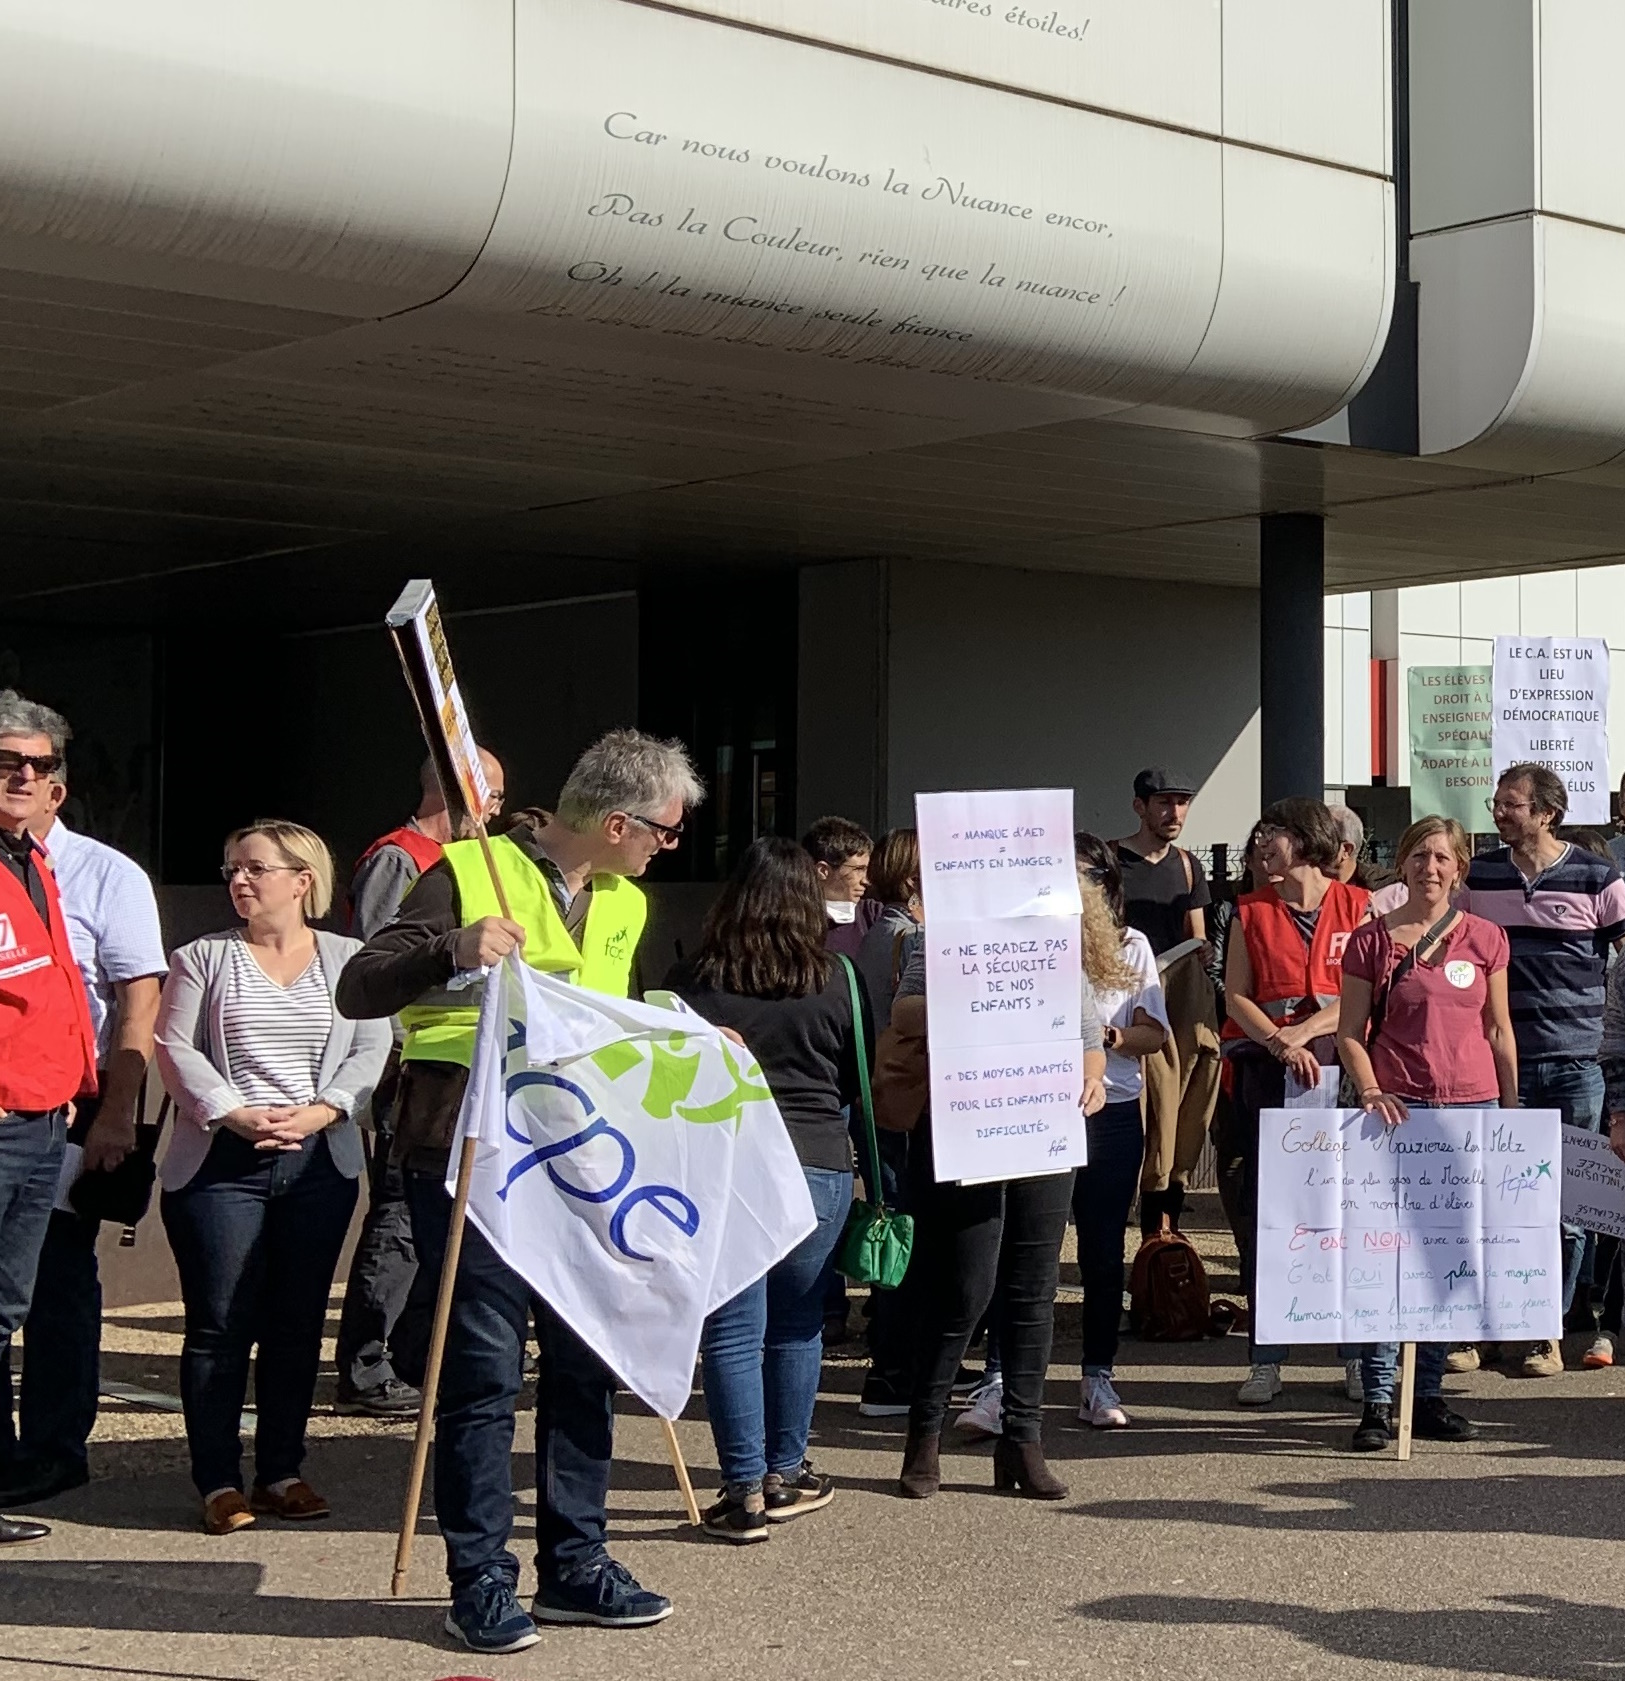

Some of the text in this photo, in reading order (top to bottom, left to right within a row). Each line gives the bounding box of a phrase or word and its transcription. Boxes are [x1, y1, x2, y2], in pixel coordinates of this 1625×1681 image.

[1005, 6, 1090, 41] étoiles!
[602, 111, 1114, 239] Car nous voulons la Nuance encor,
[588, 192, 664, 229] Pas
[676, 205, 707, 238] la
[722, 215, 844, 263] Couleur,
[859, 247, 910, 273] rien
[921, 262, 969, 290] que
[979, 262, 1005, 289] la
[1015, 278, 1102, 306] nuance
[567, 260, 622, 287] Oh
[660, 276, 691, 298] la
[702, 289, 803, 317] nuance
[814, 307, 883, 329] seule
[889, 313, 974, 345] fiance
[1509, 647, 1593, 660] LE C.A. EST UN
[1422, 676, 1441, 687] LES
[1444, 673, 1485, 686] ÉLÈVES
[1539, 669, 1565, 680] LIEU
[1434, 693, 1470, 705] DROIT
[1474, 691, 1482, 703] À
[1510, 688, 1594, 701] D'EXPRESSION
[1422, 712, 1492, 724] ENSEIGNEM
[1503, 707, 1600, 723] DÉMOCRATIQUE
[1438, 729, 1492, 742] SPÉCIALIS
[1530, 737, 1575, 751] LIBERTÉ
[1421, 755, 1467, 769] ADAPTÉ
[1567, 779, 1595, 792] ÉLUS
[964, 827, 1008, 841] MANQUE
[934, 856, 1053, 872] ENFANTS EN DANGER
[959, 939, 1068, 957] NE BRADEZ PAS
[962, 955, 1057, 975] LA SÉCURITÉ
[986, 979, 1034, 993] DE NOS
[970, 997, 1032, 1012] ENFANTS
[958, 1060, 1073, 1082] DES MOYENS ADAPTÉS
[949, 1092, 1072, 1112] POUR LES ENFANTS EN
[496, 1018, 701, 1262] cpe
[1281, 1117, 1351, 1161] Collège
[1497, 1164, 1540, 1205] fcpe
[1340, 1199, 1359, 1210] en
[1369, 1192, 1424, 1211] nombre
[1364, 1229, 1411, 1249] NON
[1422, 1236, 1449, 1245] avec
[1403, 1269, 1434, 1280] avec
[1444, 1260, 1477, 1291] plus
[1505, 1268, 1547, 1285] moyens
[1285, 1296, 1341, 1322] humains
